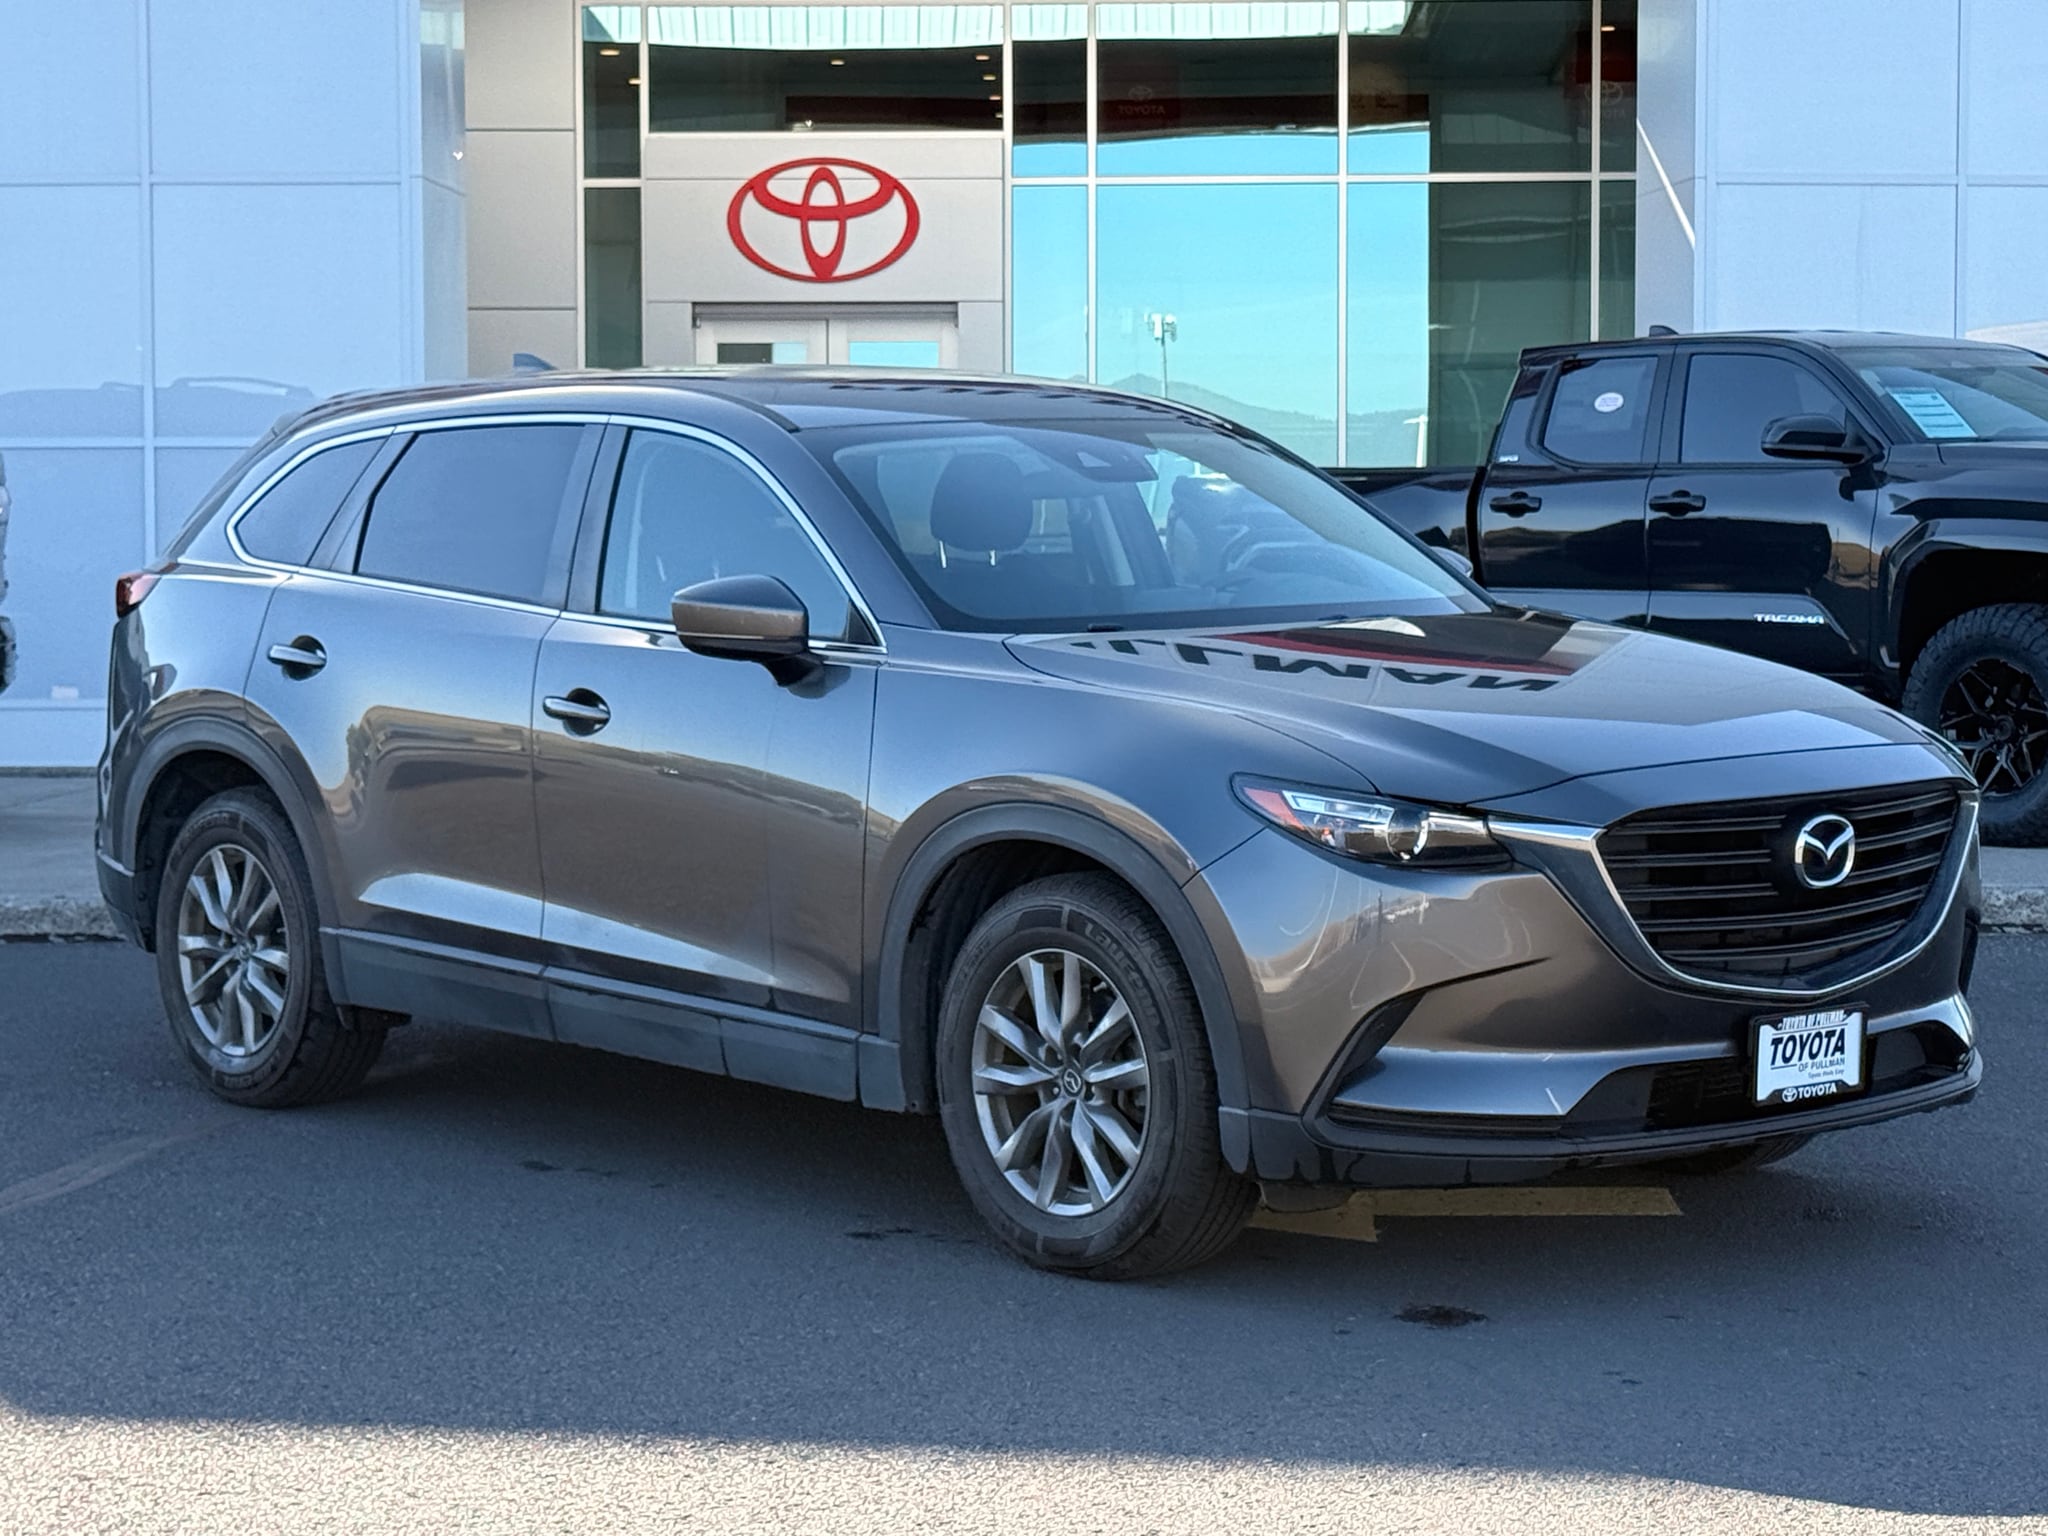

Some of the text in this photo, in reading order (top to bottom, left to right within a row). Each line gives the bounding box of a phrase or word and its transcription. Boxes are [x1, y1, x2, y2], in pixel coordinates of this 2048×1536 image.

[1753, 613, 1825, 624] TACOMA
[1771, 1028, 1845, 1066] TOYOTA
[1798, 1057, 1845, 1072] OF PULLMAN
[1798, 1083, 1837, 1098] TOYOTA
